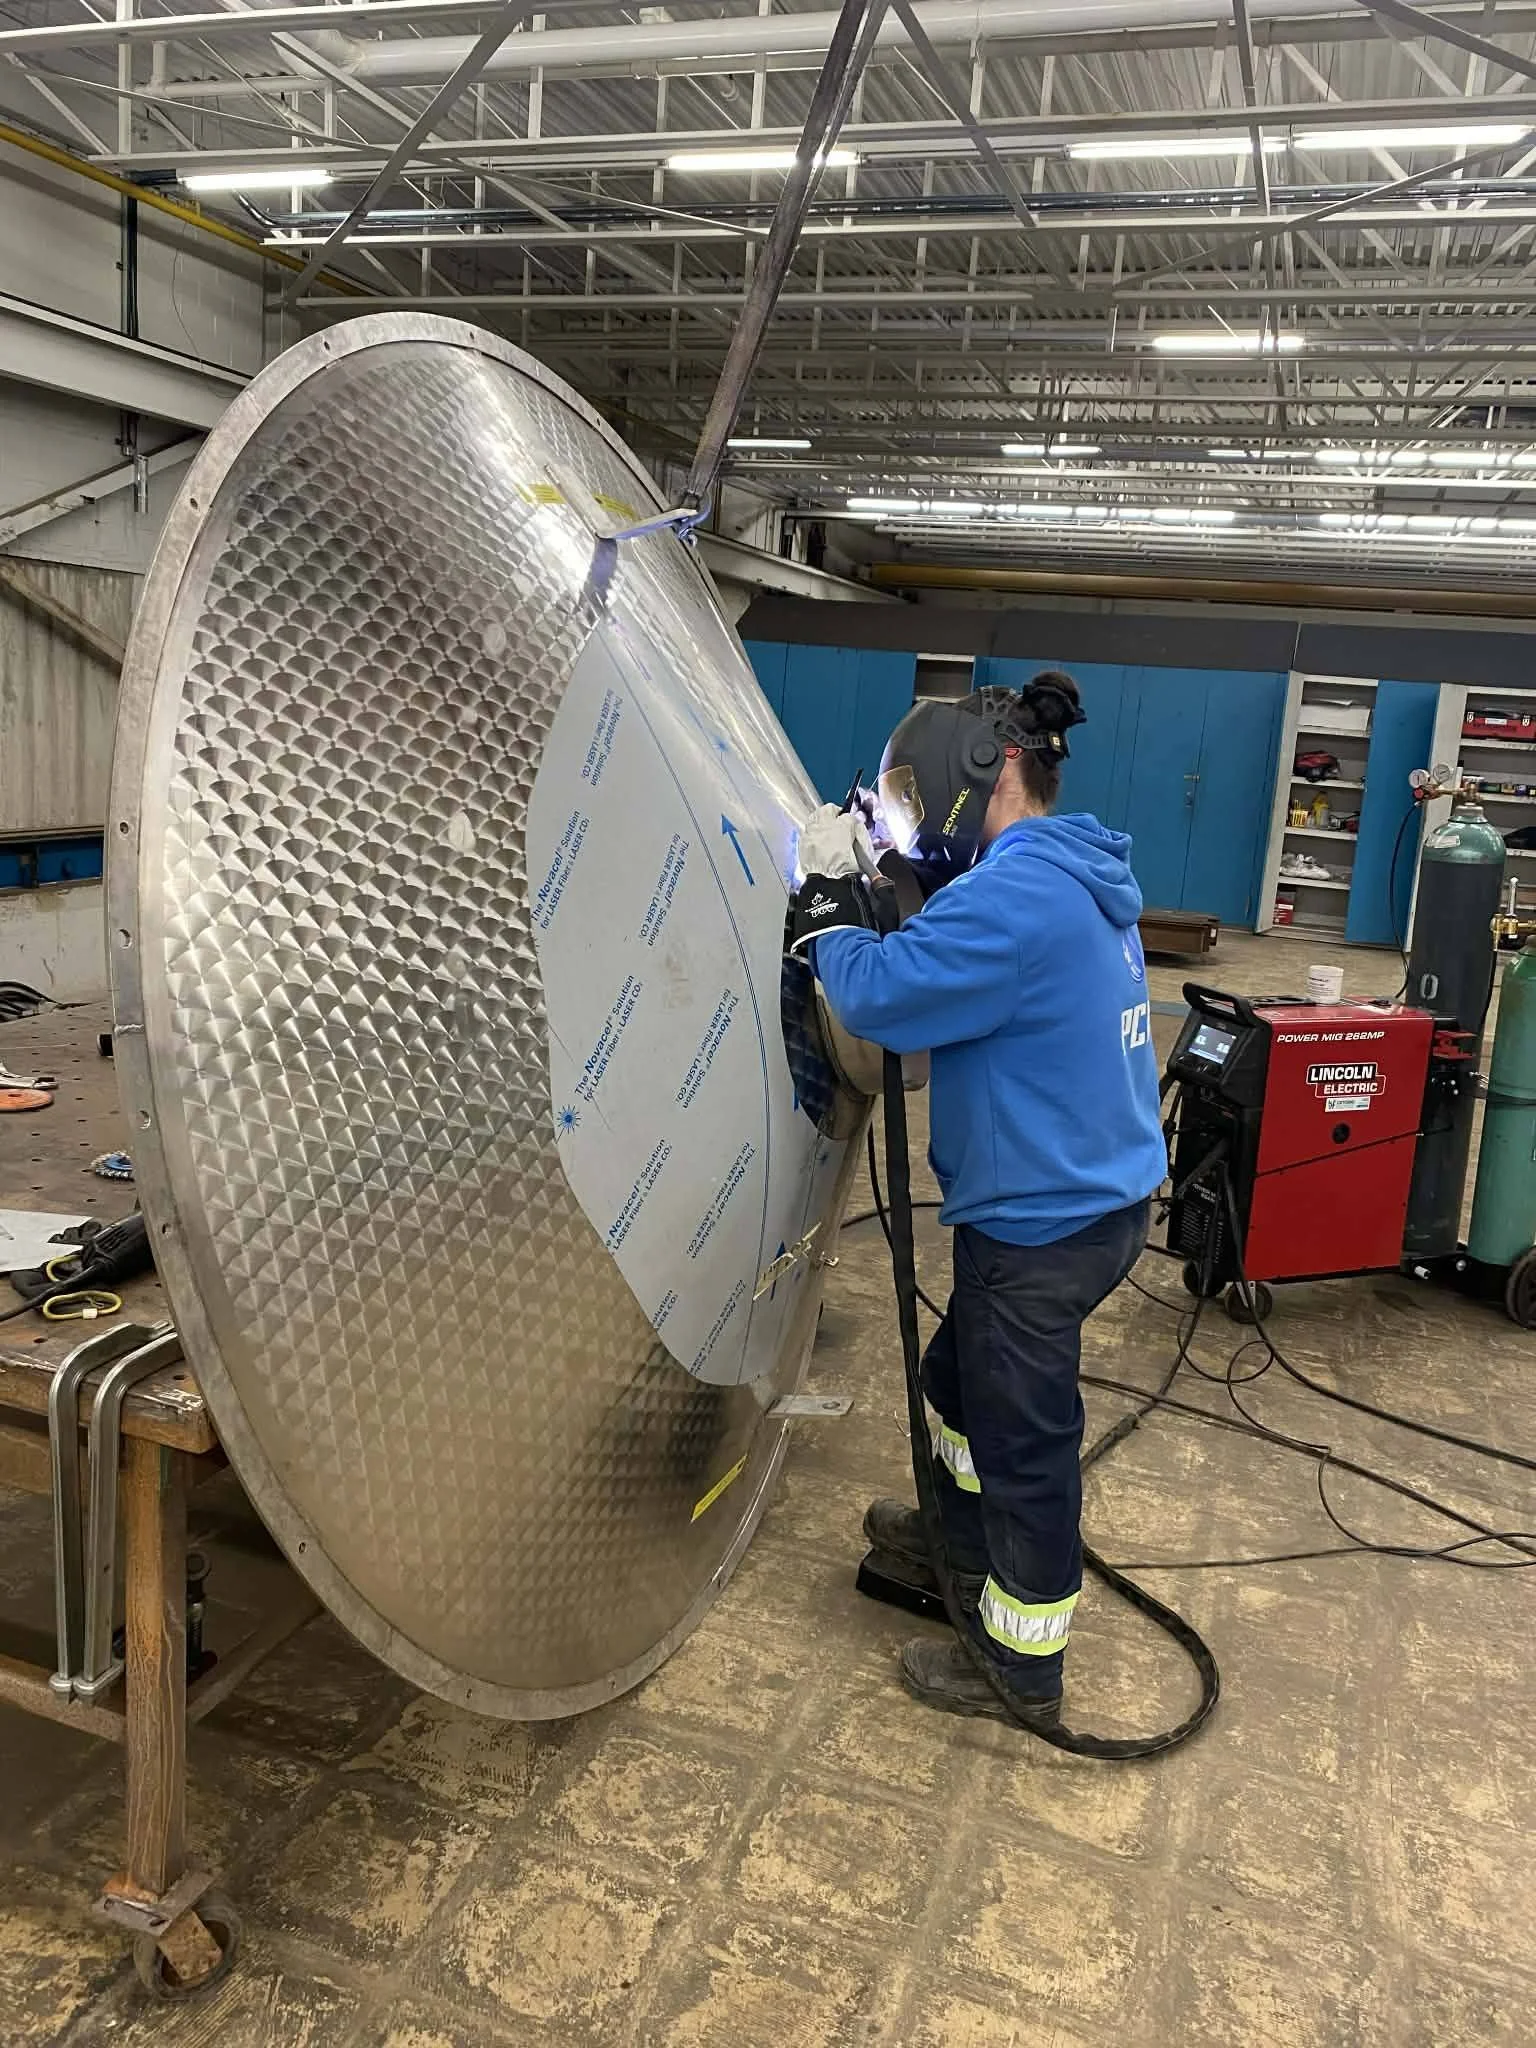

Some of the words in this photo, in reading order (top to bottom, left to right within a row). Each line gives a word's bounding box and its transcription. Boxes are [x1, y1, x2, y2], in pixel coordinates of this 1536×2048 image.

[586, 741, 600, 765] LASER
[591, 752, 608, 786] Solution
[942, 787, 970, 836] SENTINEL
[568, 833, 584, 860] LASER
[664, 844, 677, 870] LASER
[680, 841, 689, 856] The
[530, 904, 543, 921] The
[560, 811, 580, 847] Solution
[558, 865, 571, 888] Fiber
[656, 869, 668, 890] Fiber
[544, 888, 563, 916] LASER
[645, 896, 660, 922] LASER
[540, 914, 552, 930] for
[648, 908, 667, 948] Solution
[722, 989, 731, 1001] for
[728, 996, 740, 1014] The
[710, 1002, 725, 1029] LASER
[574, 1074, 590, 1095] The
[611, 976, 634, 1015] Solution
[701, 1029, 713, 1052] Fiber
[1276, 1034, 1319, 1043] POWER
[1320, 1033, 1343, 1042] MIG
[583, 1087, 596, 1103] for
[590, 1058, 609, 1087] LASER
[605, 1034, 620, 1058] Fiber
[619, 999, 636, 1027] LASER
[684, 1058, 701, 1086] LASER
[1310, 1065, 1374, 1082] LINCOLN
[682, 1069, 706, 1108] Solution
[1323, 1082, 1379, 1095] ELECTRIC
[640, 1139, 665, 1180] Solution
[740, 1142, 750, 1155] for
[744, 1148, 757, 1165] The
[726, 1155, 744, 1181] LASER
[613, 1221, 632, 1250] LASER
[629, 1196, 644, 1220] Fiber
[645, 1162, 663, 1190] LASER
[715, 1183, 728, 1204] Fiber
[696, 1210, 712, 1238] LASER
[691, 1220, 716, 1259] Solution
